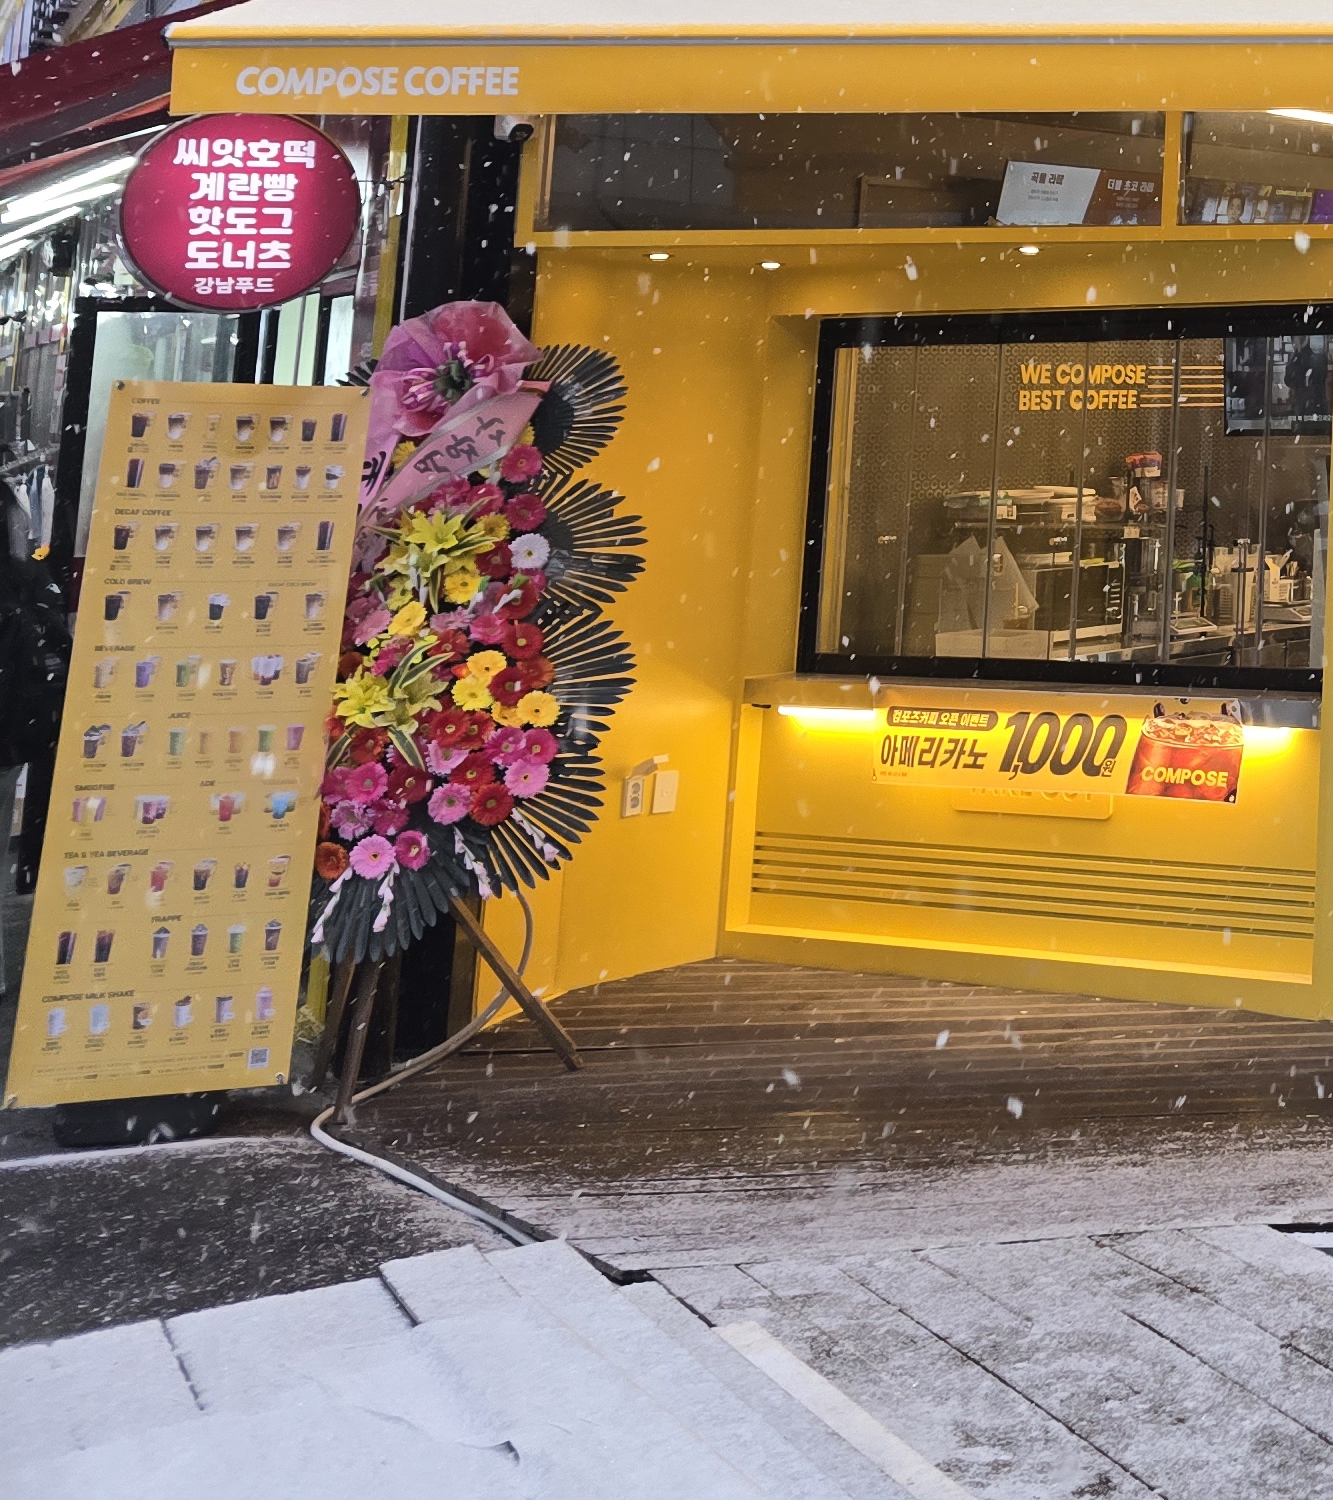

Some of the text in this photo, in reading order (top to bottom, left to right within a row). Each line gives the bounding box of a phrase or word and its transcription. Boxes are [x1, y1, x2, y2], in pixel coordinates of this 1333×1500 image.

[236, 66, 519, 97] COMPOSE COFFEE
[173, 136, 316, 170] 씨앗호떡
[190, 173, 298, 202] 계란빵
[188, 207, 294, 236] 핫도그
[185, 240, 291, 270] 도너츠
[194, 276, 276, 295] 강남푸드
[1020, 364, 1146, 385] WE COMPOSE
[1019, 390, 1138, 411] BEST COFFEE
[892, 709, 989, 728] 컴포즈커피 오픈 이벤트
[881, 734, 988, 770] 아메리카노
[1141, 765, 1230, 788] COMPOSE
